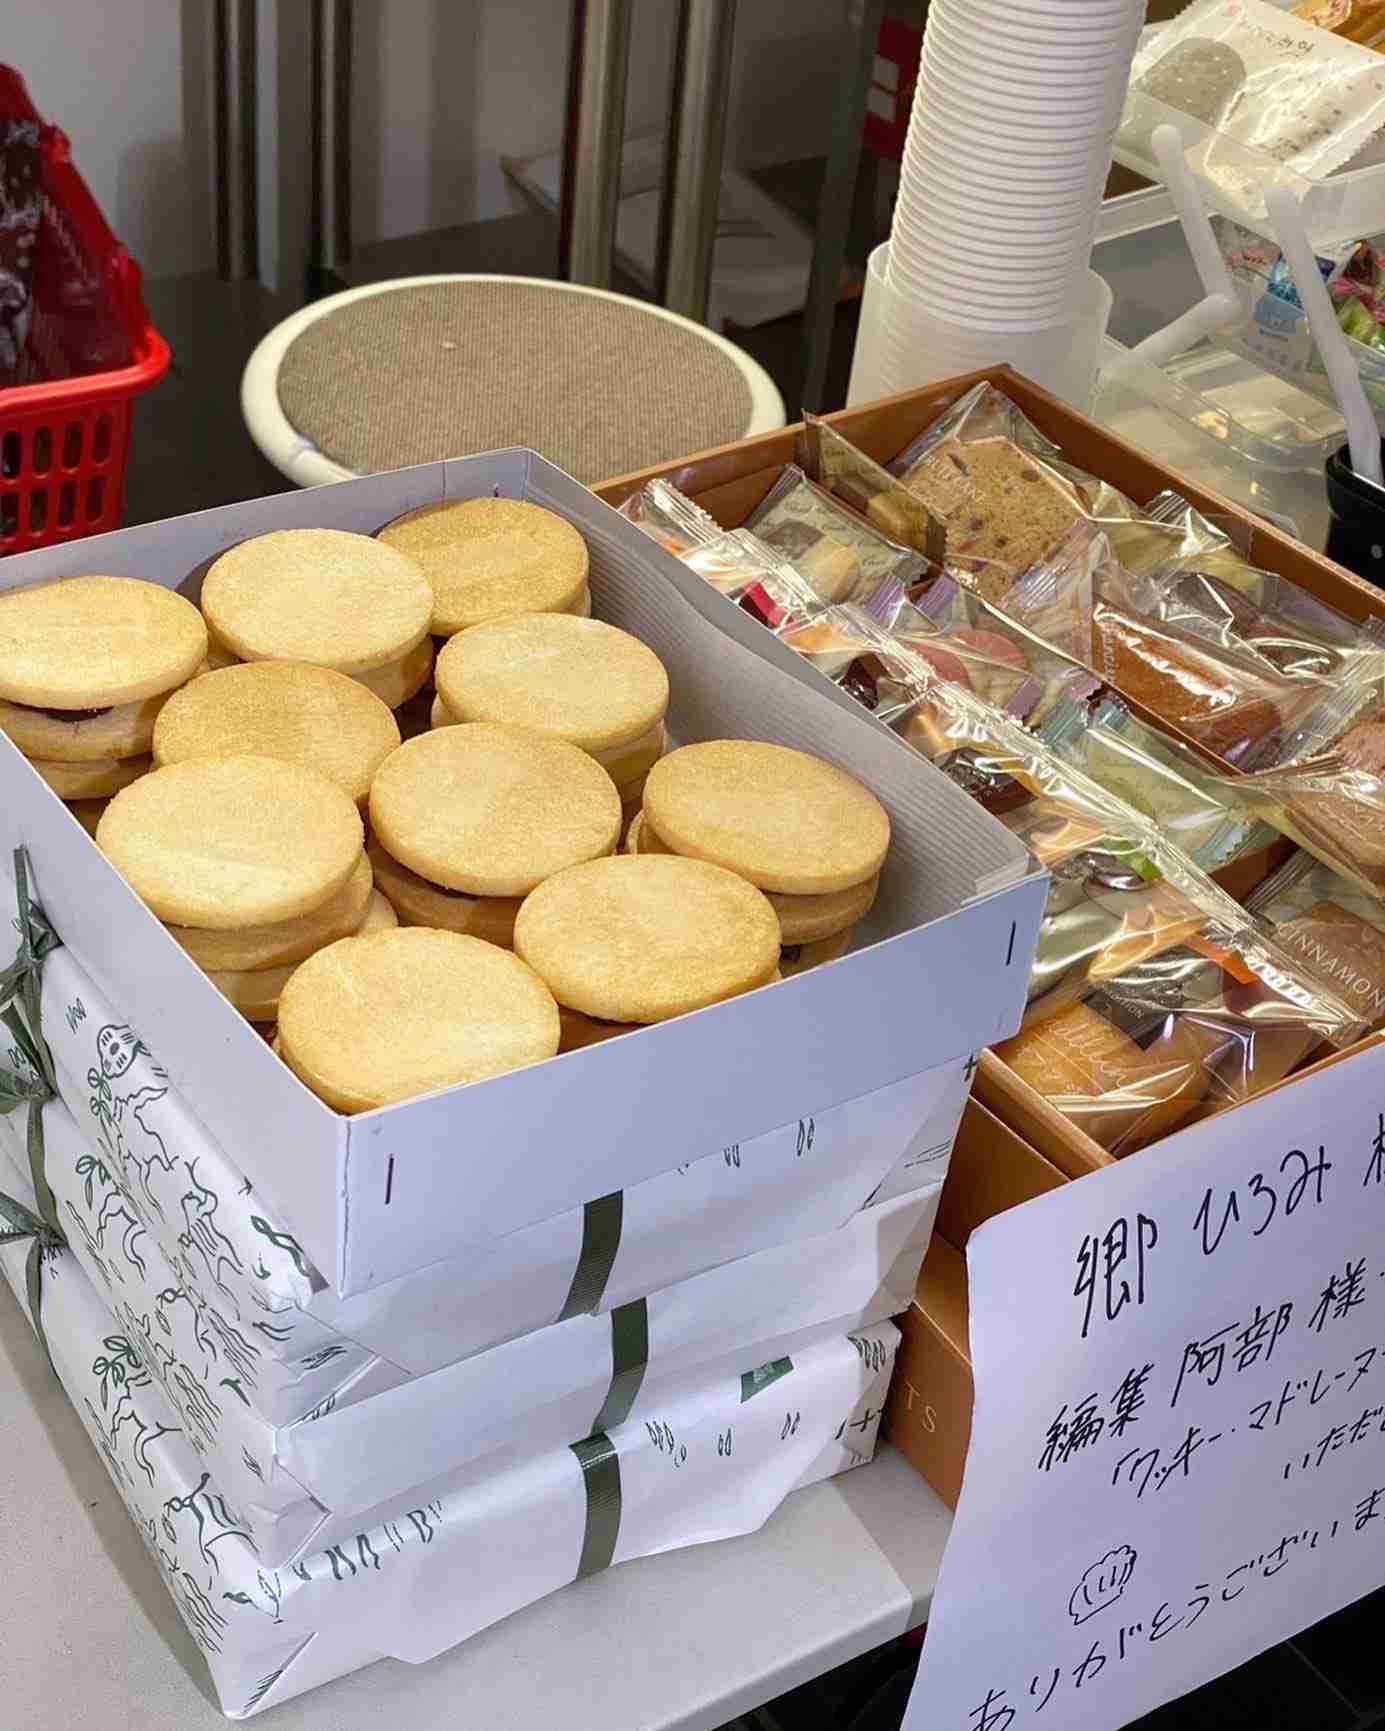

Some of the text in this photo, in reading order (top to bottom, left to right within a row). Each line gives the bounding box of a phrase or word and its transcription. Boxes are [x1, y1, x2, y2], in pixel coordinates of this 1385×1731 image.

[1278, 922, 1385, 1009] CINNAMON
[1283, 1405, 1385, 1480] いただ
[968, 1487, 1385, 1731] ありがとうございま
